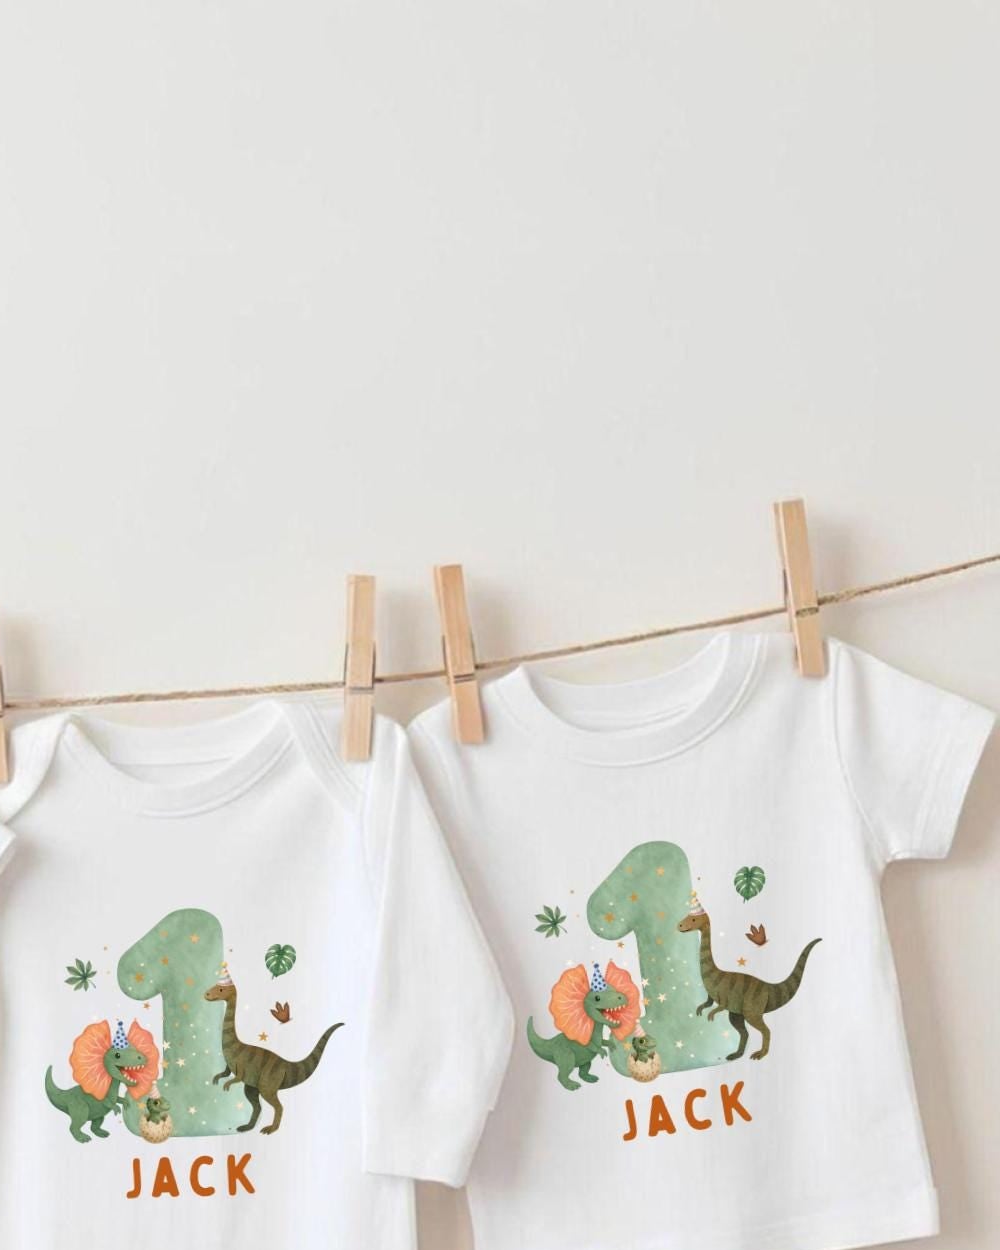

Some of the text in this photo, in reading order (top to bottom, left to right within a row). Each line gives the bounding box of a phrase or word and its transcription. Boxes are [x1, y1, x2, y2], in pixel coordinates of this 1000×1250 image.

[117, 908, 248, 1138] 1
[586, 840, 737, 1074] 1
[125, 1152, 256, 1200] JACK
[621, 1080, 753, 1143] JACK
